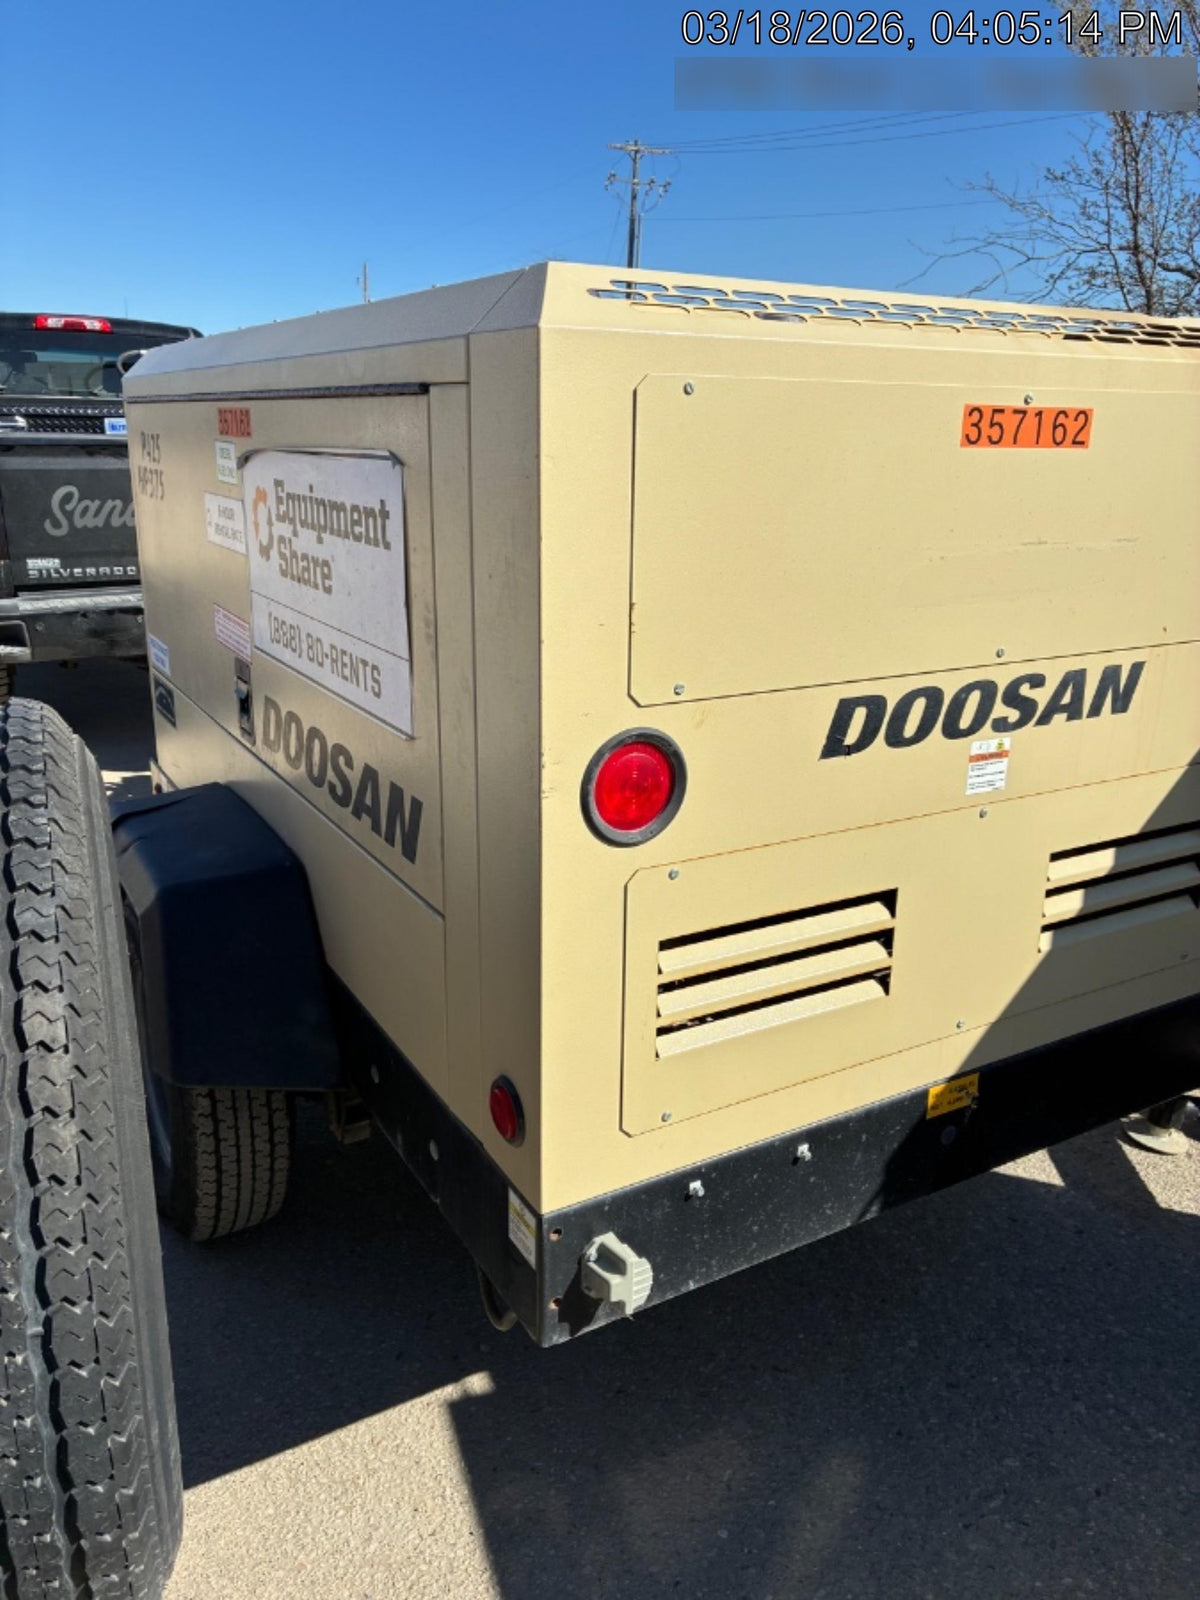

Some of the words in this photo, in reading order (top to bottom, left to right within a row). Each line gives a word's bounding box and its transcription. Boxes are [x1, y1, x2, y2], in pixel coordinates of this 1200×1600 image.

[965, 407, 1089, 446] 357162
[273, 478, 392, 550] Equipment
[28, 566, 138, 579] SILVERADO
[277, 535, 333, 595] Share
[269, 612, 302, 659] (888)
[307, 631, 382, 699] 80-RENTS
[819, 661, 1146, 761] DOOSAN
[262, 694, 424, 866] DOOSAN
